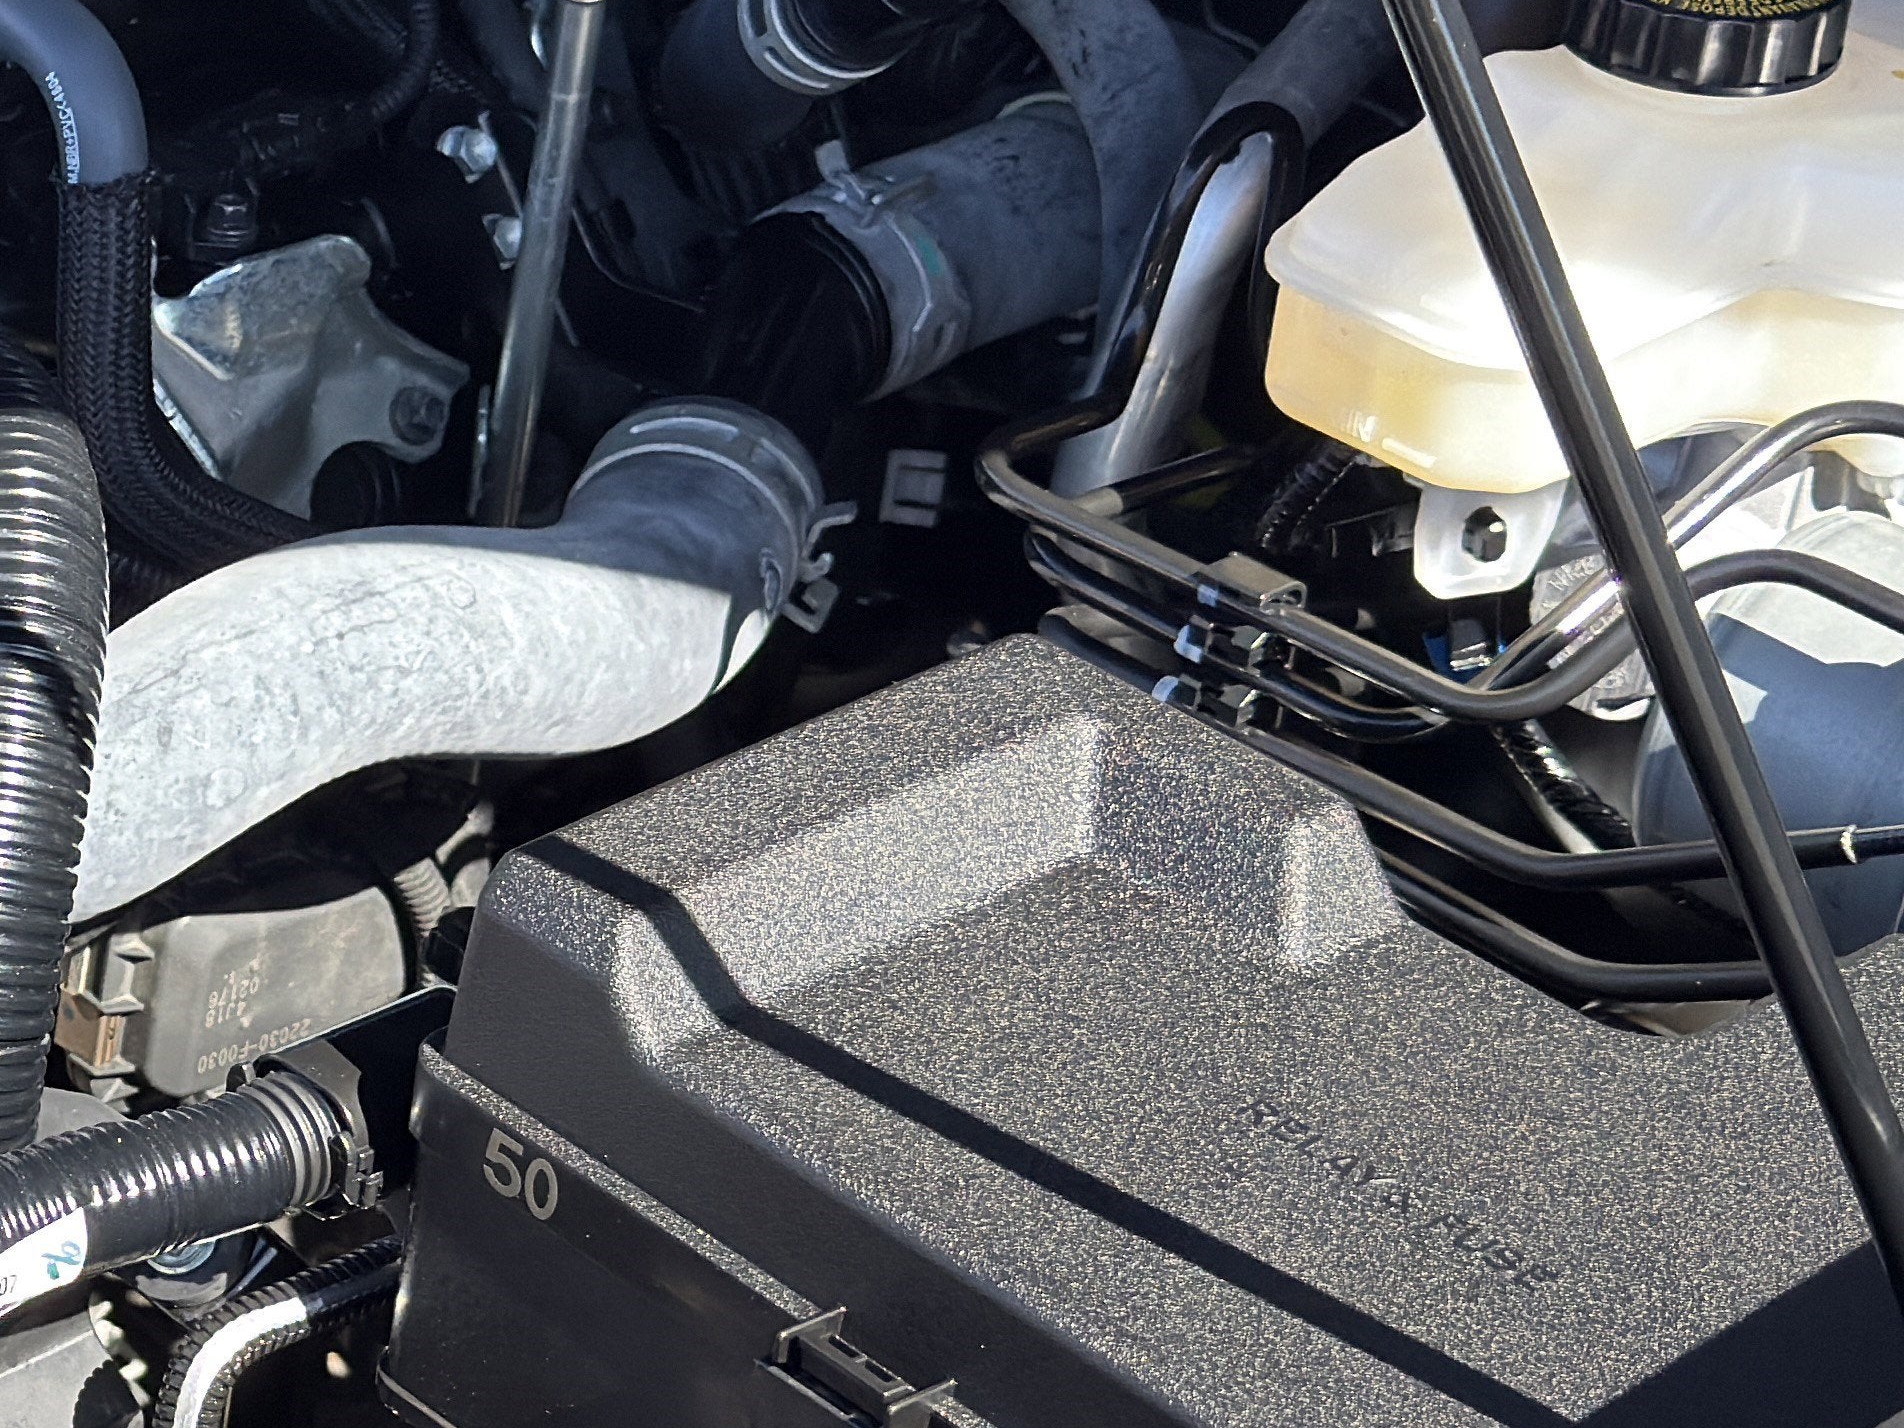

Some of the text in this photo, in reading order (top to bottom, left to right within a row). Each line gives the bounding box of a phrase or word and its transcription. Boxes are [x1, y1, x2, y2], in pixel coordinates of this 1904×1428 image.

[482, 1127, 560, 1222] 50
[1234, 1098, 1395, 1187] RELAY
[1428, 1210, 1560, 1288] FUSE
